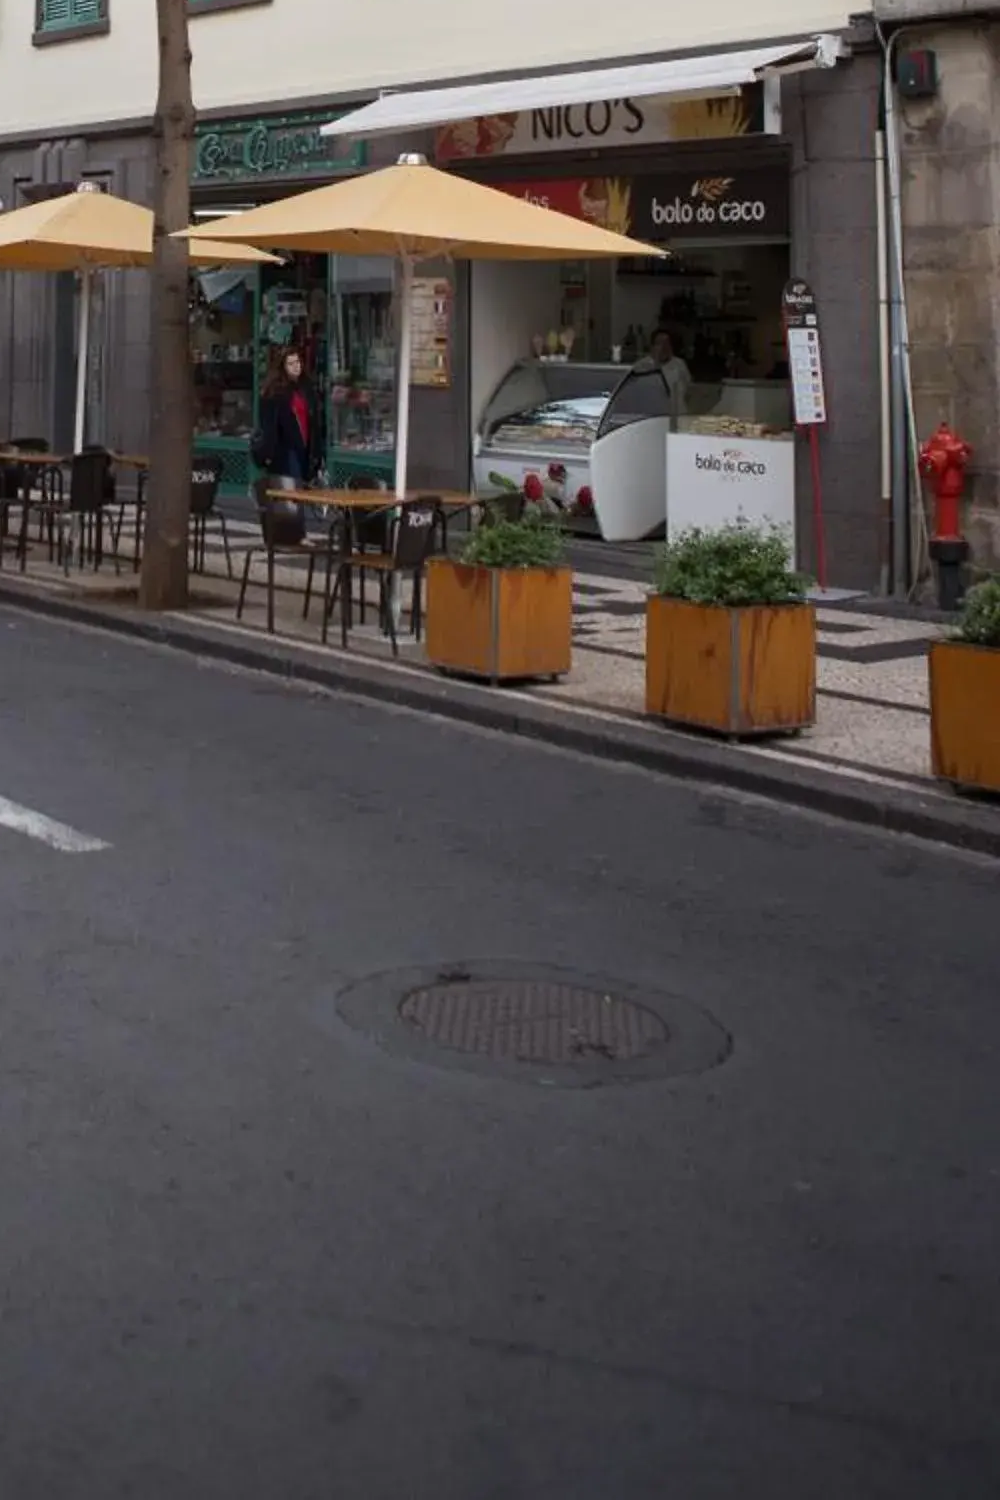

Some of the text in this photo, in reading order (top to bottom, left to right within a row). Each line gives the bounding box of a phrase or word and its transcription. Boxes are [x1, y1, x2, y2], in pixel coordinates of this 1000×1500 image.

[531, 98, 644, 141] NICO'S
[652, 197, 765, 224] bolo do caco
[695, 452, 721, 471] bolo
[737, 461, 766, 475] caco
